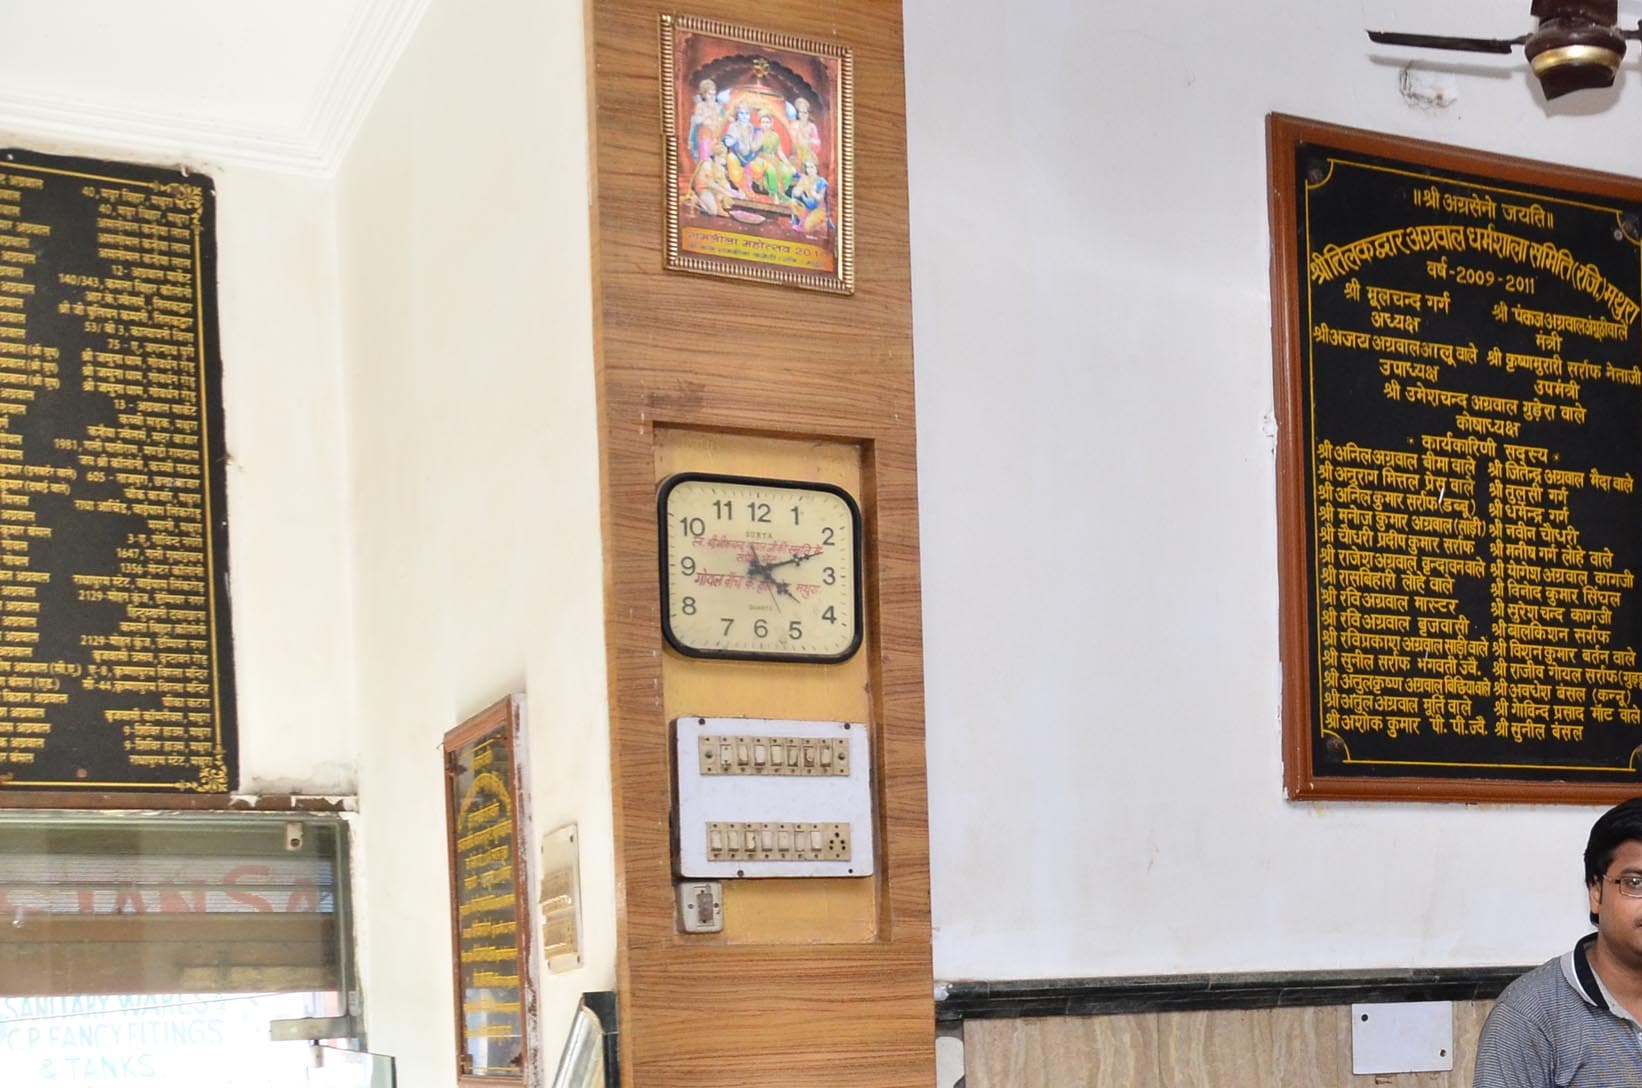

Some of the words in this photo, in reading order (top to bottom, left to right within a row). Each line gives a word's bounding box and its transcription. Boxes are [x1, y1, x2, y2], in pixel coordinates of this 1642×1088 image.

[1406, 225, 1465, 251] अग्रवाल
[1467, 223, 1529, 263] धर्मशाला
[1344, 278, 1360, 301] श्री
[1425, 292, 1451, 315] गर्ग
[1371, 311, 1421, 334] अध्यक्ष
[1492, 301, 1508, 323] श्री
[1313, 322, 1329, 343] श्री
[1456, 342, 1478, 365] वाले
[1536, 330, 1563, 352] मंत्री
[1487, 347, 1502, 367] श्री
[1379, 358, 1439, 383] उपाध्यक्ष
[1534, 379, 1580, 401] उपमंत्री
[1384, 379, 1401, 400] श्री
[1471, 395, 1519, 416] अग्रवाल
[1560, 402, 1587, 425] वाले
[1456, 411, 1520, 438] कोषाध्यक्ष
[1318, 440, 1332, 459] श्री
[1451, 456, 1476, 475] वाले
[1422, 432, 1497, 458] कार्यकारिणी
[1504, 443, 1548, 463] सदस्य
[1318, 461, 1333, 481] श्री
[1450, 476, 1475, 495] वाले
[1318, 482, 1333, 501] श्री
[1373, 492, 1404, 510] कुमार
[1489, 479, 1504, 499] श्री
[1548, 486, 1569, 505] गर्ग
[713, 500, 733, 520] 11
[748, 502, 771, 523] 12
[791, 506, 800, 525] 1
[1489, 499, 1503, 519] श्री
[1548, 507, 1569, 524] गर्ग
[680, 517, 705, 536] 10
[822, 527, 835, 545] 2
[1489, 518, 1503, 538] श्री
[1505, 521, 1536, 541] नवीन
[1320, 523, 1334, 543] श्री
[1408, 535, 1440, 554] कुमार
[681, 556, 695, 576] 9
[823, 567, 835, 585] 3
[1490, 558, 1504, 578] श्री
[1543, 567, 1588, 586] अग्रवाल
[1321, 565, 1336, 585] श्री
[1429, 574, 1455, 595] वाले
[1491, 578, 1504, 598] श्री
[1545, 587, 1579, 605] कुमार
[682, 596, 696, 615] 8
[822, 606, 837, 624] 4
[721, 618, 734, 636] 7
[754, 619, 768, 638] 6
[789, 621, 802, 639] 5
[1325, 689, 1339, 708] श्री
[1448, 695, 1472, 717] वाले
[1495, 718, 1508, 738] श्री
